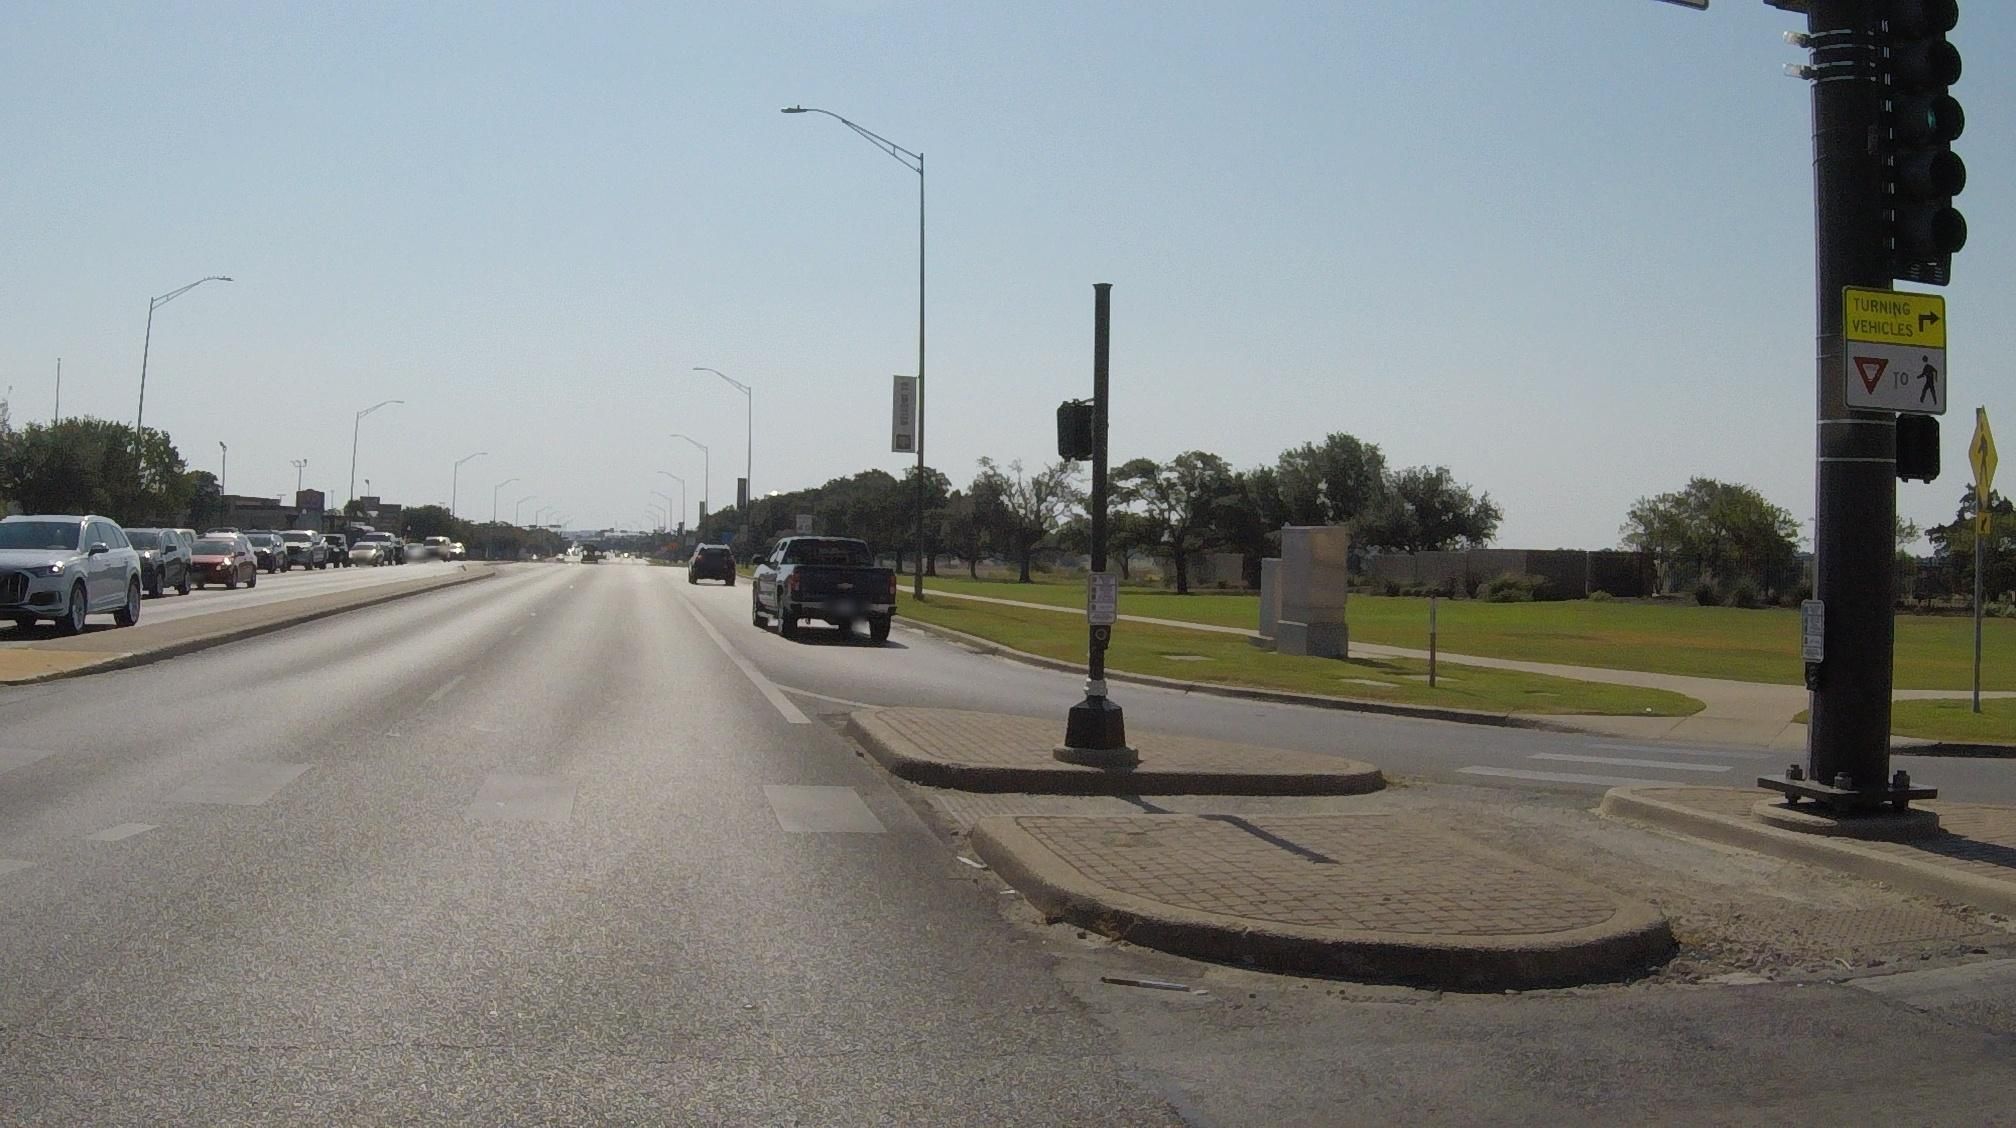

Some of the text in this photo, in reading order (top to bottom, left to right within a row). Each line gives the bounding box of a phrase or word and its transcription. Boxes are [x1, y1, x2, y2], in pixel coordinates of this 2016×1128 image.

[1853, 296, 1911, 316] TURNING
[1852, 319, 1914, 337] VEHICLES
[1893, 371, 1909, 389] TO
